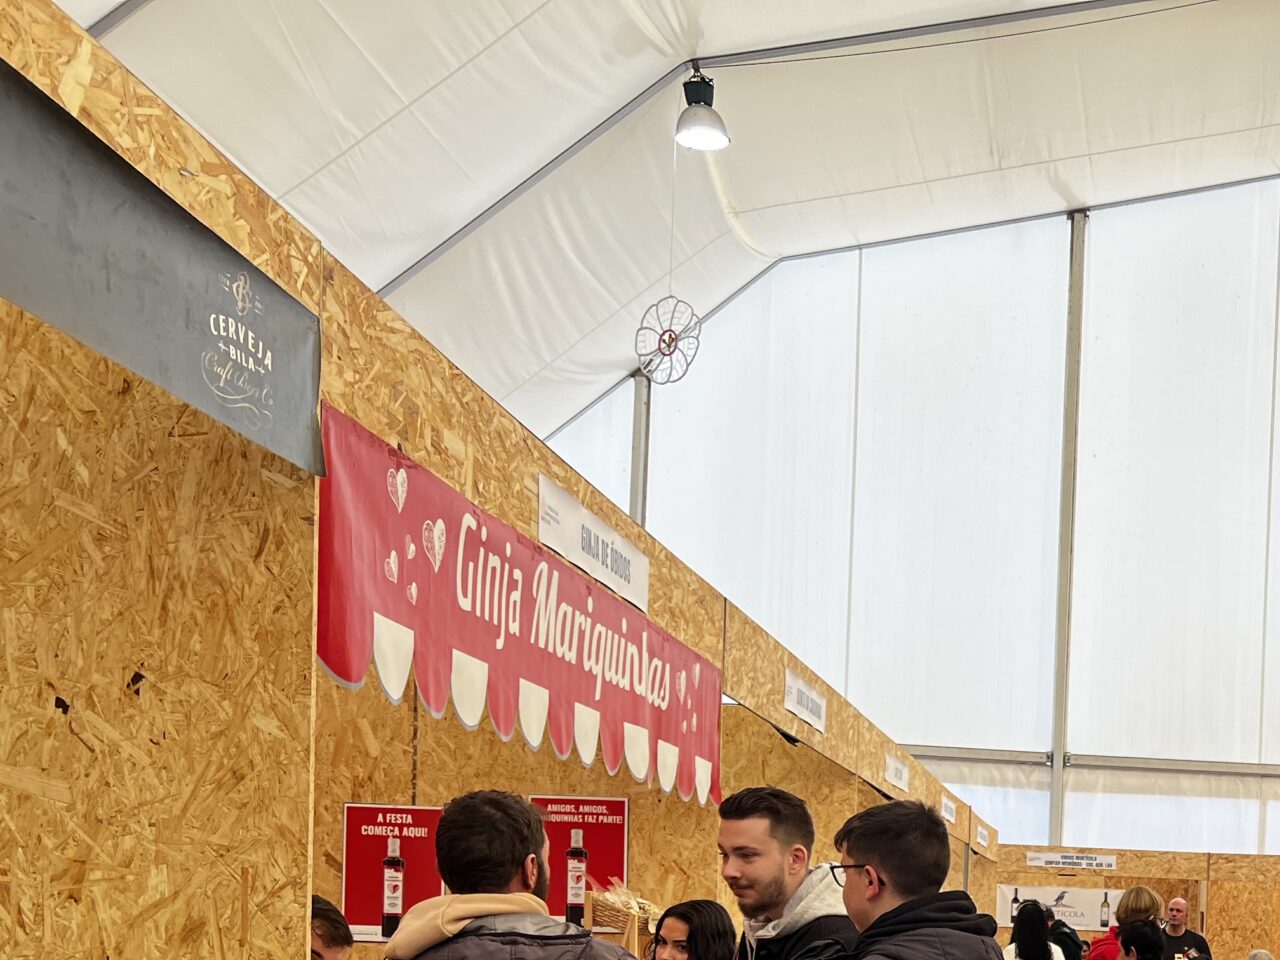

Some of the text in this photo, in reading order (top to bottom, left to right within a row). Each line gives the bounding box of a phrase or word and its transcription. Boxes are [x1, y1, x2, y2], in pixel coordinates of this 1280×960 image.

[209, 314, 272, 371] CERVEJA
[229, 344, 255, 371] BILA
[581, 524, 631, 584] GINJA DE ÓBIDOS
[456, 512, 671, 711] Ginja Mariquinhas
[547, 804, 609, 814] AMIGOS, AMIGOS,
[377, 813, 413, 824] A FESTA
[584, 815, 597, 824] FAZ
[598, 816, 623, 824] PARTE!
[361, 825, 428, 838] COMEÇA AQUI!
[1056, 908, 1085, 918] TÍCOLA
